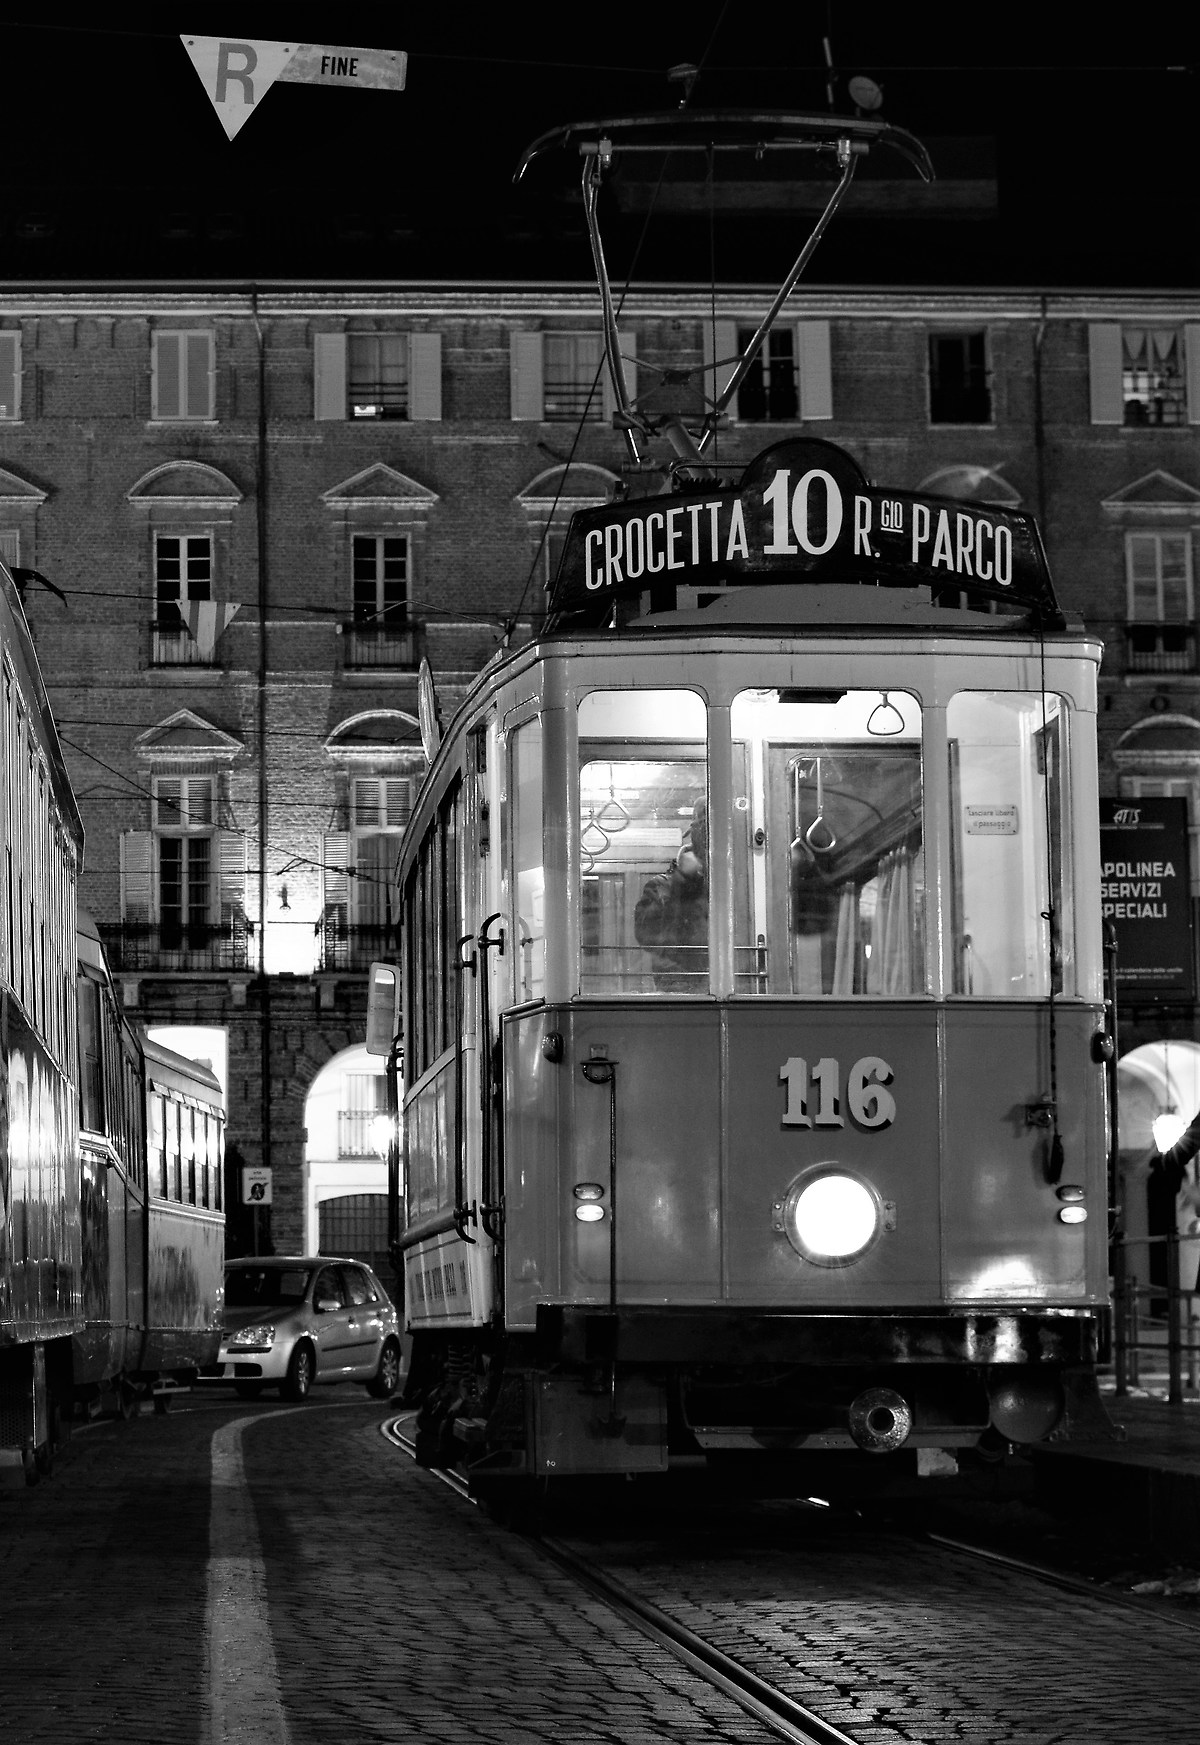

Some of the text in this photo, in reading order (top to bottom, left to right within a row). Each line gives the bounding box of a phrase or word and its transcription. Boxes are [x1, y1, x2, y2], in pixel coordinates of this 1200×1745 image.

[215, 42, 258, 105] R
[321, 55, 359, 77] FINE
[585, 498, 750, 590] CROCETTA
[762, 469, 844, 555] 10
[911, 503, 1013, 587] PARCO
[1102, 902, 1167, 919] PECIALI
[778, 1056, 898, 1133] 116
